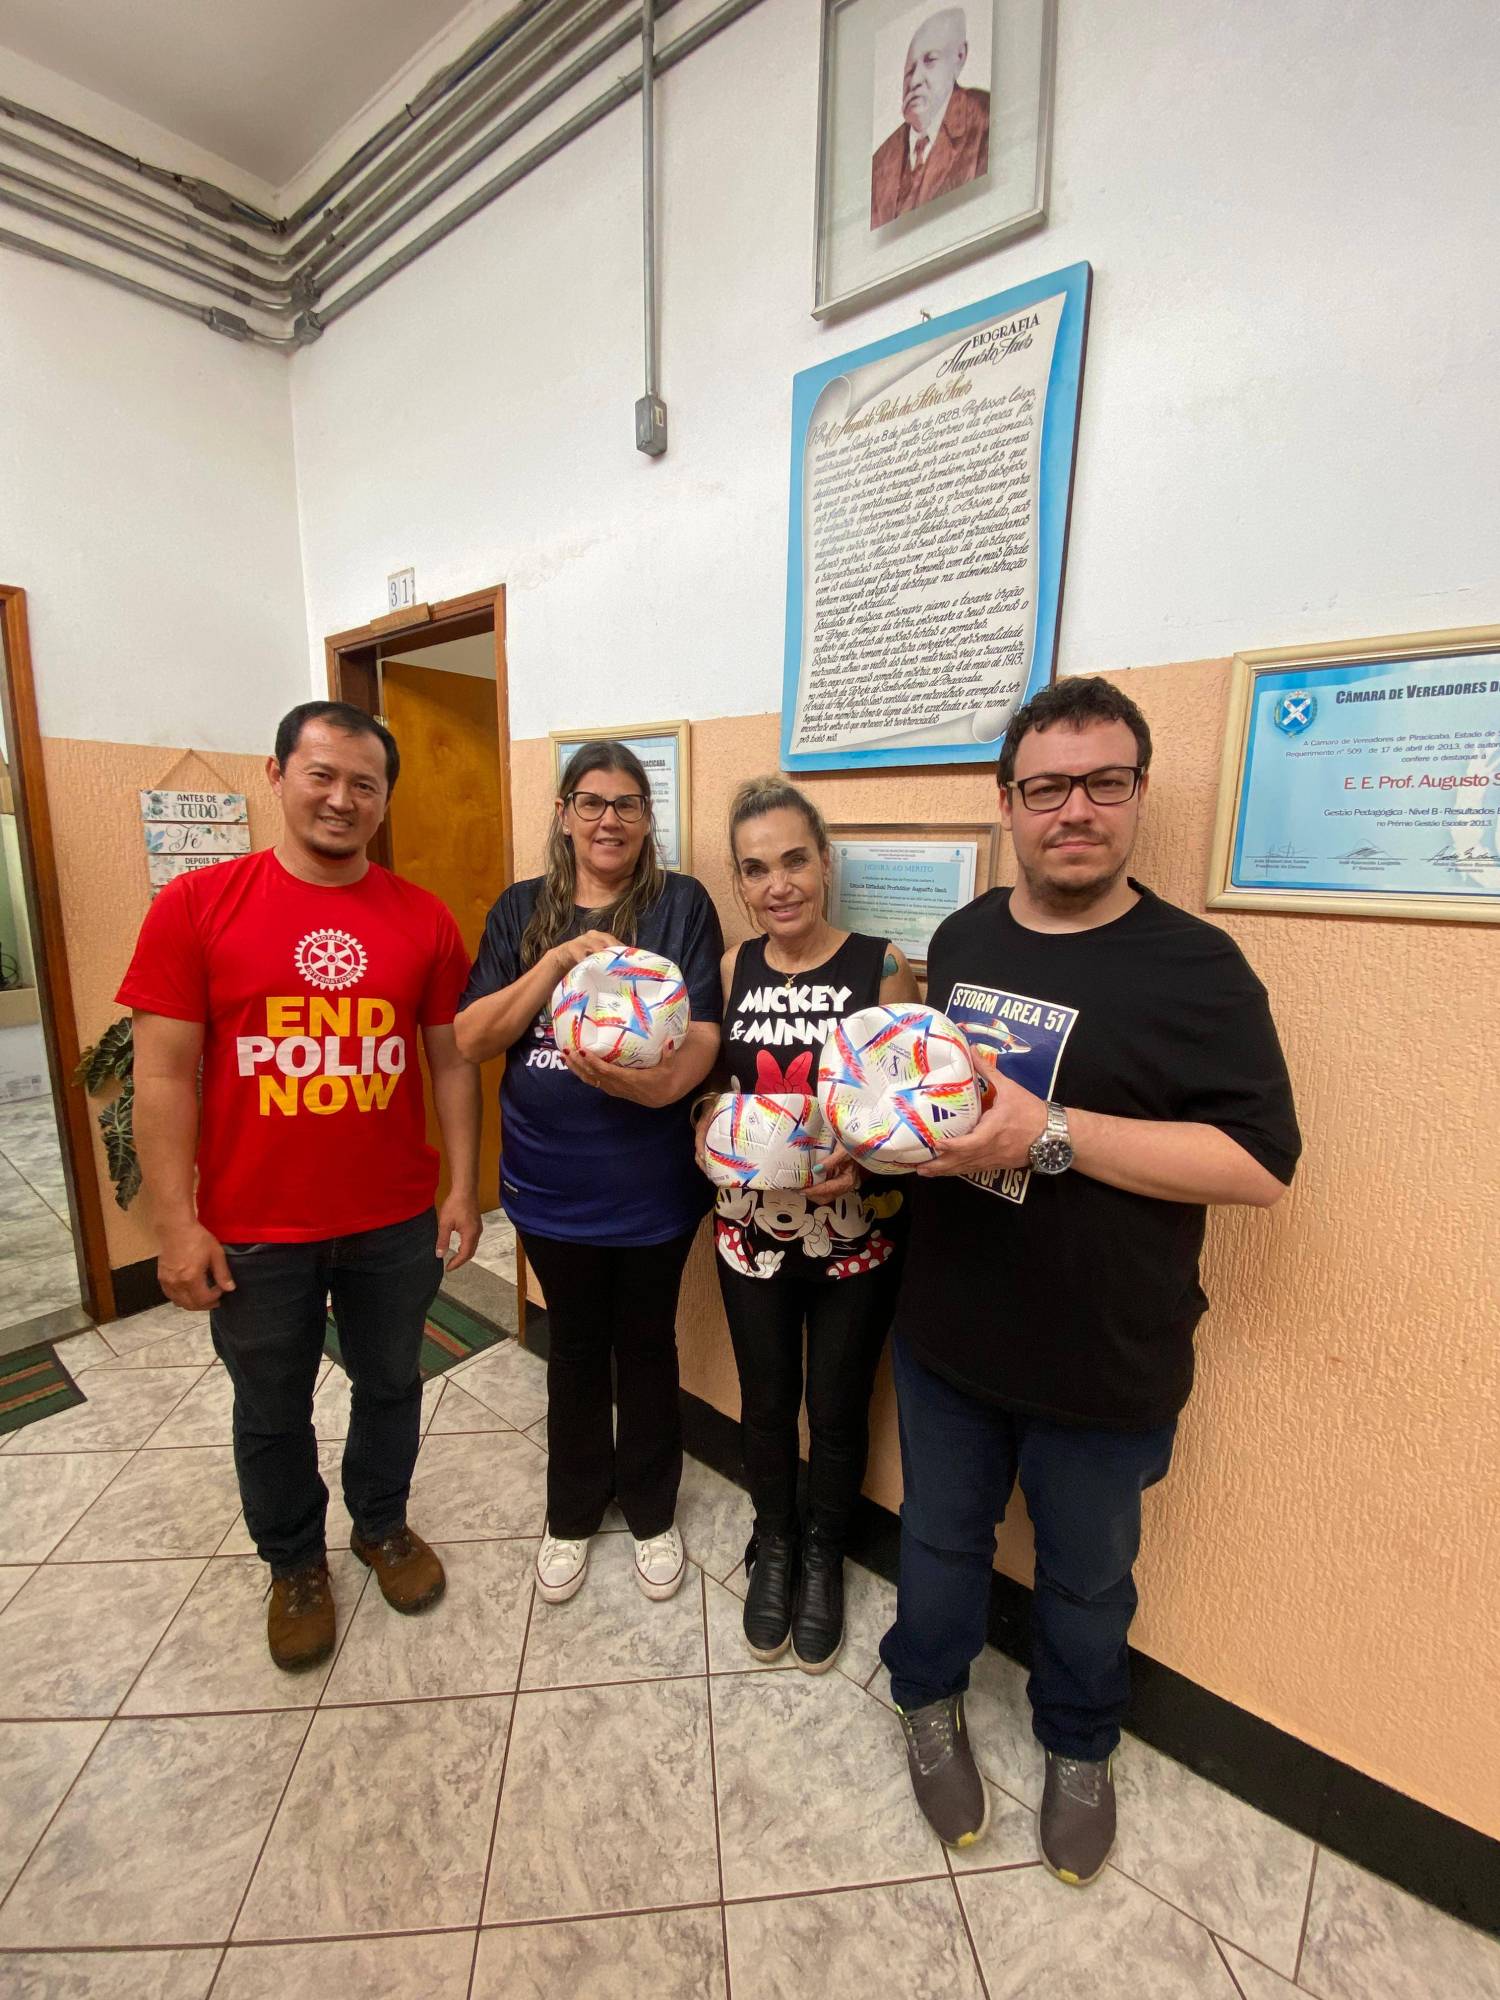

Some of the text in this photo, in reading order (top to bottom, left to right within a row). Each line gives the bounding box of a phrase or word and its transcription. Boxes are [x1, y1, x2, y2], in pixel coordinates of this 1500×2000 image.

[972, 312, 1040, 348] BIOGRAFIA
[935, 339, 996, 379] Augusto
[921, 422, 964, 442] Governo
[938, 428, 1030, 464] dezenas dezenas
[1008, 445, 1027, 465] que
[935, 479, 954, 492] com
[951, 487, 1027, 513] Assim que
[1011, 498, 1031, 513] aos
[937, 528, 964, 544] alunos
[964, 513, 1029, 543] piracicabanos
[974, 529, 1026, 549] destaque
[945, 557, 963, 568] com
[1003, 538, 1029, 557] tarde
[899, 555, 1027, 591] destaque na administração
[880, 617, 892, 631] da
[916, 611, 955, 625] ensinava
[964, 604, 985, 618] seus
[986, 598, 1020, 614] alunos
[921, 599, 950, 617] piano
[959, 590, 992, 605] tocava
[911, 622, 940, 639] hortas
[946, 618, 987, 639] pomares.
[957, 622, 1023, 650] personalidade
[961, 656, 971, 671] de
[990, 652, 1001, 667] de
[1001, 652, 1023, 666] 1913.
[964, 679, 1001, 700] exemplo
[1389, 688, 1403, 699] DE
[1406, 681, 1487, 698] VEREADORES
[983, 697, 1010, 708] nome
[1353, 736, 1394, 744] Vereadores
[1455, 731, 1482, 739] Estado
[1405, 744, 1423, 752] abril
[1401, 754, 1430, 762] confere
[1441, 753, 1478, 761] destaque
[1379, 774, 1414, 789] Prof.
[1418, 773, 1489, 790] Augusto
[177, 794, 217, 803] ANTES DE
[178, 803, 218, 818] TUDO
[1324, 808, 1352, 816] Gestão
[1354, 808, 1402, 817] Pedagógica
[1409, 807, 1430, 816] Nível
[1444, 807, 1495, 815] Resultados
[165, 824, 201, 852] Fé
[185, 857, 210, 865] DEPOIS
[737, 984, 853, 1014] MICKEY
[953, 988, 1067, 1032] STORM AREA 51
[266, 996, 396, 1038] END
[743, 1017, 846, 1046] MINNI
[236, 1036, 406, 1078] POLIO
[526, 1047, 569, 1071] FOR
[259, 1073, 400, 1116] NOW
[1001, 1168, 1023, 1198] US
